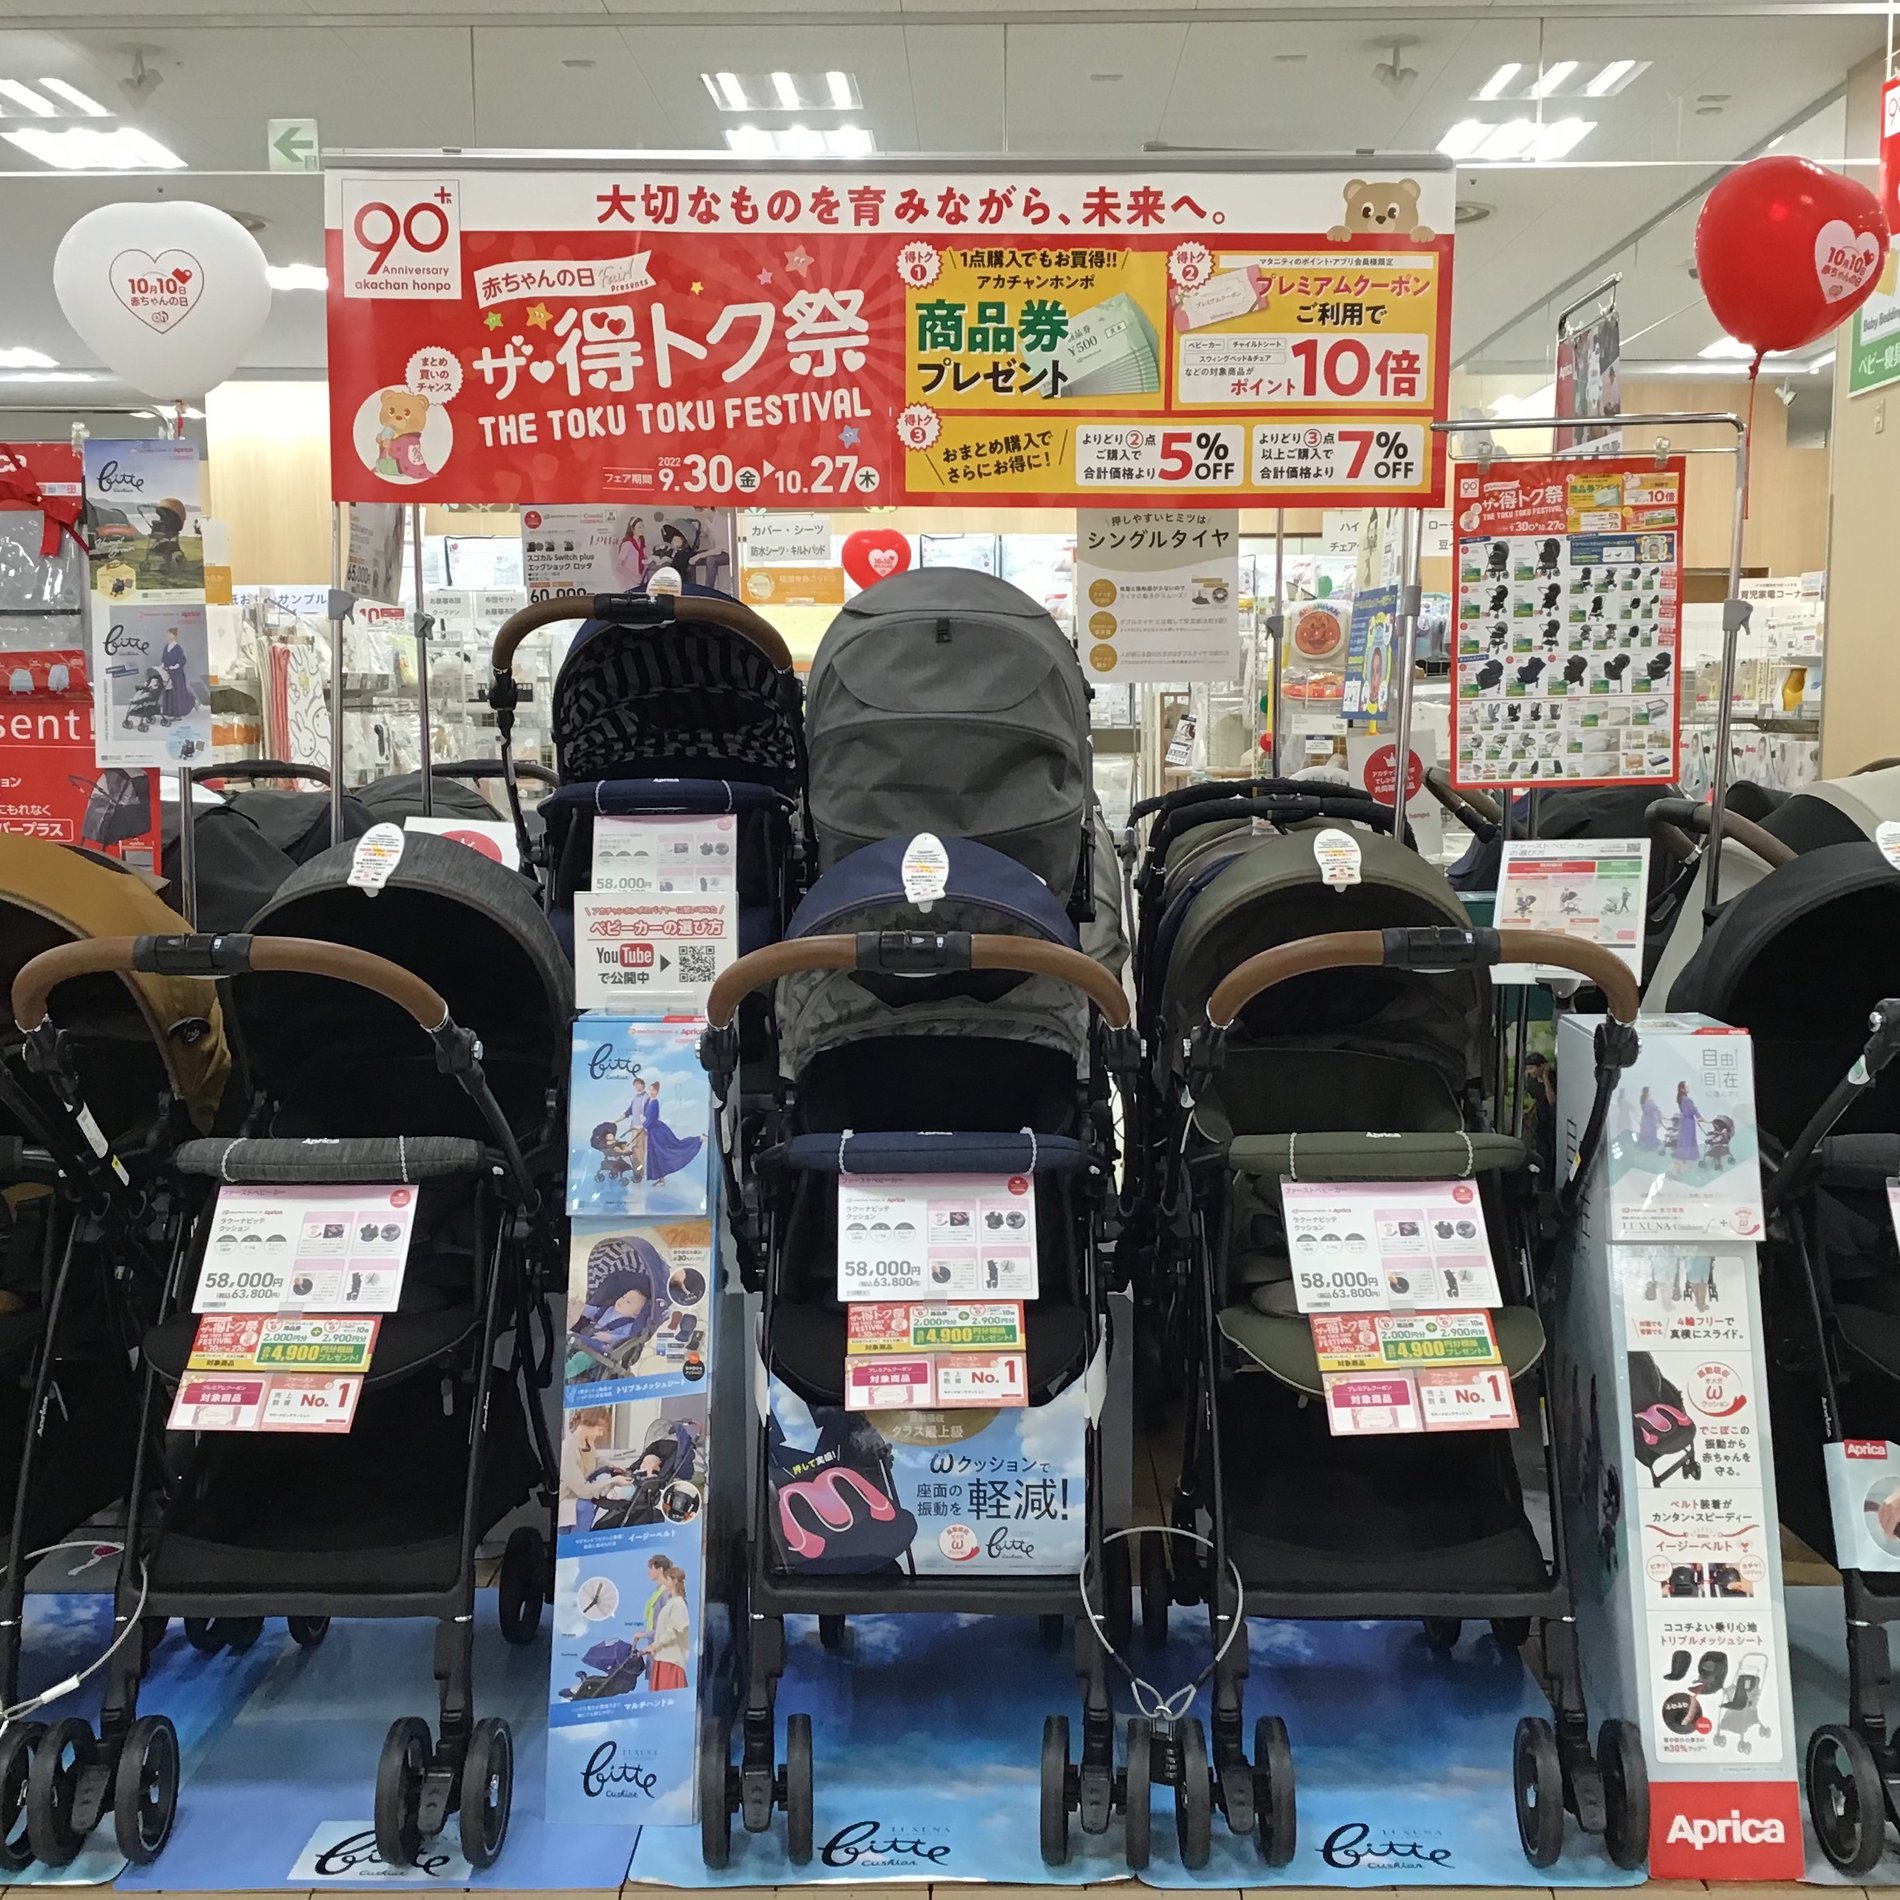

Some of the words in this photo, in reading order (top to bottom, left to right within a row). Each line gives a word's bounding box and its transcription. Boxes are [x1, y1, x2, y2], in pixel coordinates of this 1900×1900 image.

[596, 184, 1227, 228] 大切なものを育みながら、未来へ。
[382, 265, 450, 277] Anniversary
[355, 279, 408, 291] akachan
[413, 279, 452, 293] honpo
[482, 267, 596, 301] 赤ちゃんの日
[977, 273, 1096, 290] アカチャンホンポ
[1256, 273, 1430, 297] プレミアムクーポン
[130, 296, 189, 307] 赤ちゃんの日
[1296, 302, 1388, 326] ご利用で
[914, 298, 1069, 353] 商品券
[420, 356, 449, 369] まとめ
[419, 369, 450, 382] 買いの
[917, 357, 1069, 398] プレゼント
[417, 381, 453, 394] チャンス
[1231, 377, 1296, 397] ポイント
[479, 407, 537, 447] THE
[552, 405, 626, 442] TOKU
[637, 398, 717, 436] TOKU
[726, 386, 871, 430] FESTIVAL
[943, 430, 1054, 464] おまとめ購入で
[1095, 449, 1143, 461] ご購入で
[1261, 449, 1335, 460] 以上ご購入で
[658, 457, 681, 467] 2022
[1083, 467, 1157, 480] 合計価格より
[1194, 462, 1235, 481] OFF
[1259, 466, 1335, 479] 合計価格より
[1374, 462, 1414, 480] OFF
[604, 473, 653, 485] フェア期間
[1111, 513, 1207, 527] 押しやすいヒミツは
[1088, 528, 1230, 550] シングルタイヤ
[554, 553, 578, 561] Switch
[579, 552, 595, 562] plus
[590, 918, 724, 937] ベビーカーの選び方
[597, 971, 650, 985] で公開中
[926, 1327, 974, 1344] 4,900
[271, 1345, 320, 1362] 4,900
[1397, 1341, 1446, 1358] 4,900
[869, 1374, 911, 1383] 対象商品
[200, 1393, 242, 1403] 対象商品
[1350, 1395, 1393, 1405] 対象商品
[891, 1425, 964, 1439] クラス最上級
[1700, 1425, 1750, 1436] でこぼこの
[1705, 1438, 1747, 1450] 振動から
[1847, 1443, 1886, 1457] Aprica
[1702, 1452, 1751, 1463] 赤ちゃんを
[916, 1483, 963, 1499] 座面の
[967, 1478, 1069, 1521] 軽減!
[1670, 1499, 1732, 1510] ベルト装着が
[917, 1501, 962, 1517] 振動を
[1656, 1540, 1733, 1552] イージーベルト
[1664, 1622, 1758, 1633] ココチよい乗り心地
[1660, 1635, 1763, 1646] トリプルメッシュシート
[1666, 1809, 1785, 1850] Aprica
